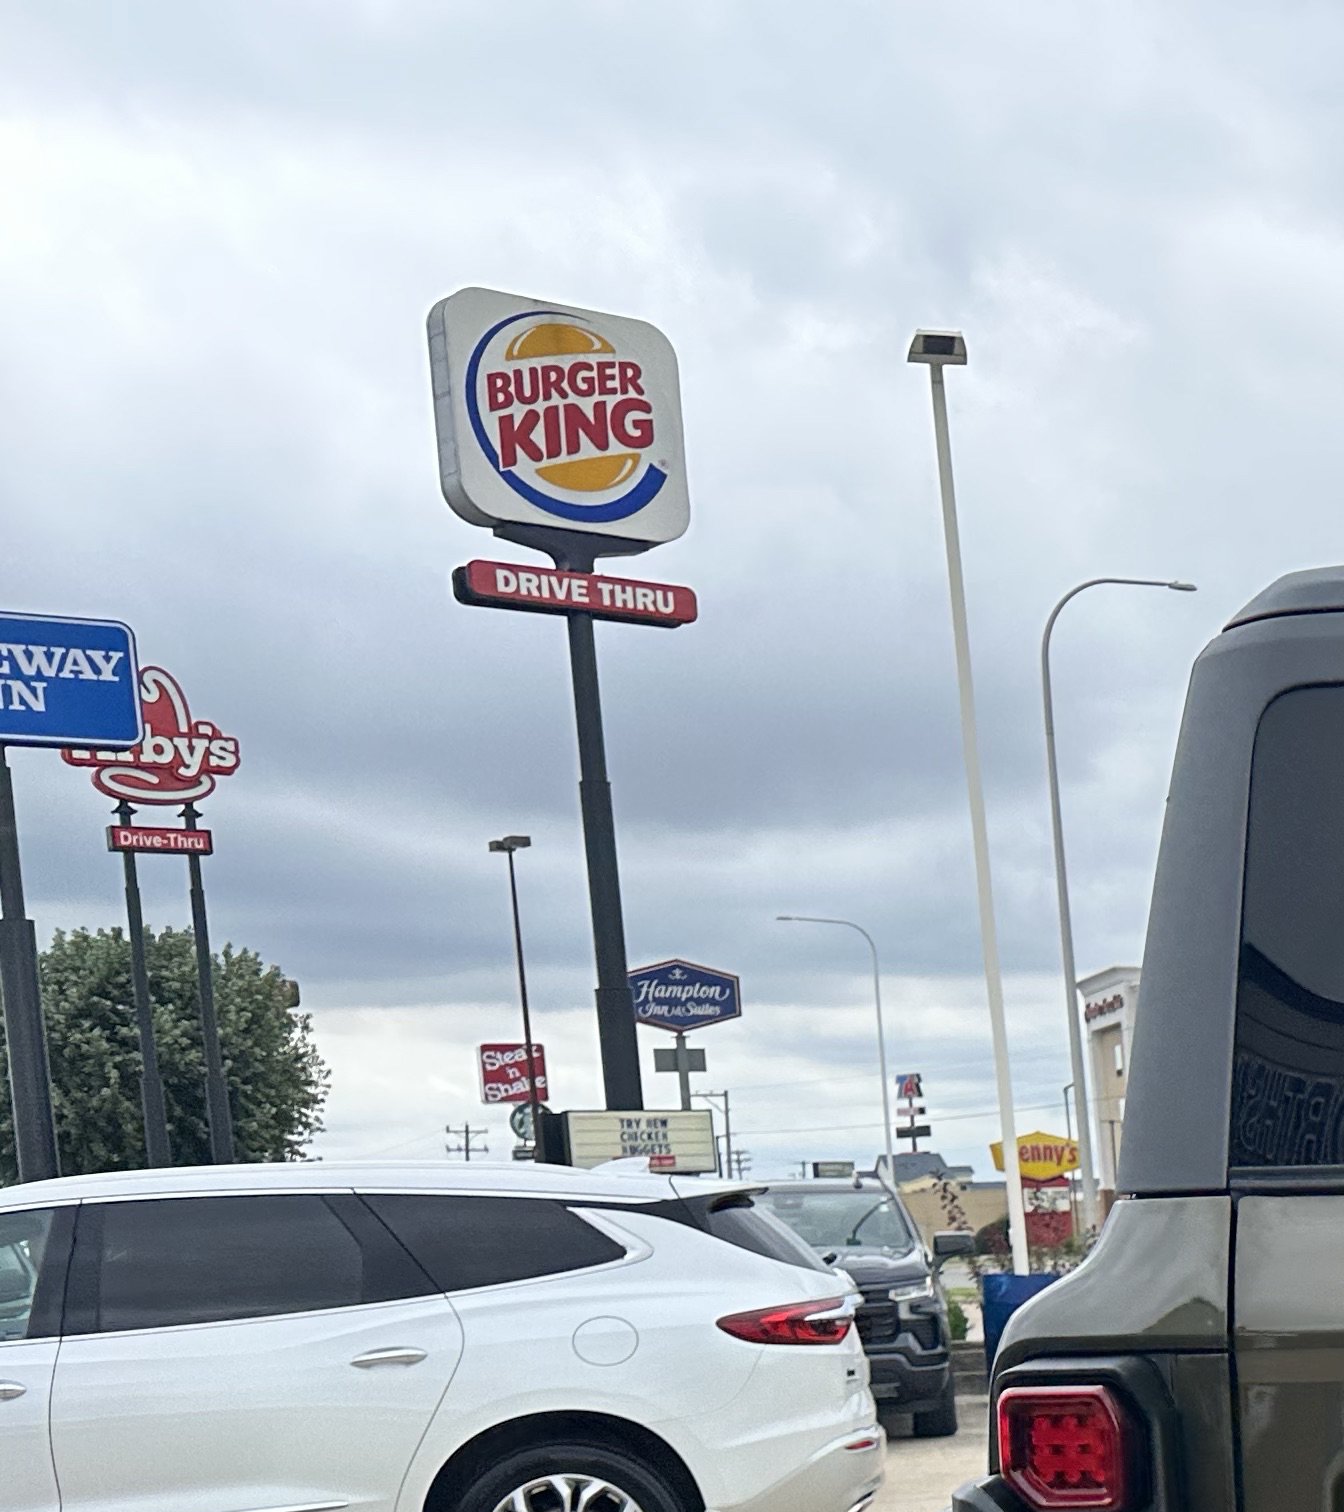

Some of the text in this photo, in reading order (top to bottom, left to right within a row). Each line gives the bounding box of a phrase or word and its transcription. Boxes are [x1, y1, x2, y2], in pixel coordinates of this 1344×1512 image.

[487, 361, 645, 412] BURGER
[498, 398, 655, 469] KING
[496, 569, 675, 614] DRIVE THRU
[0, 680, 47, 712] N
[72, 723, 237, 777] by's
[119, 831, 204, 849] Drive-Thru
[634, 980, 730, 1003] Hampton
[638, 1002, 673, 1018] Inn
[683, 1001, 721, 1017] Suites
[619, 1118, 668, 1129] TRY NEW
[620, 1131, 668, 1142] CHICKEN
[622, 1144, 672, 1155] NUGGETS
[1020, 1143, 1077, 1166] enny's
